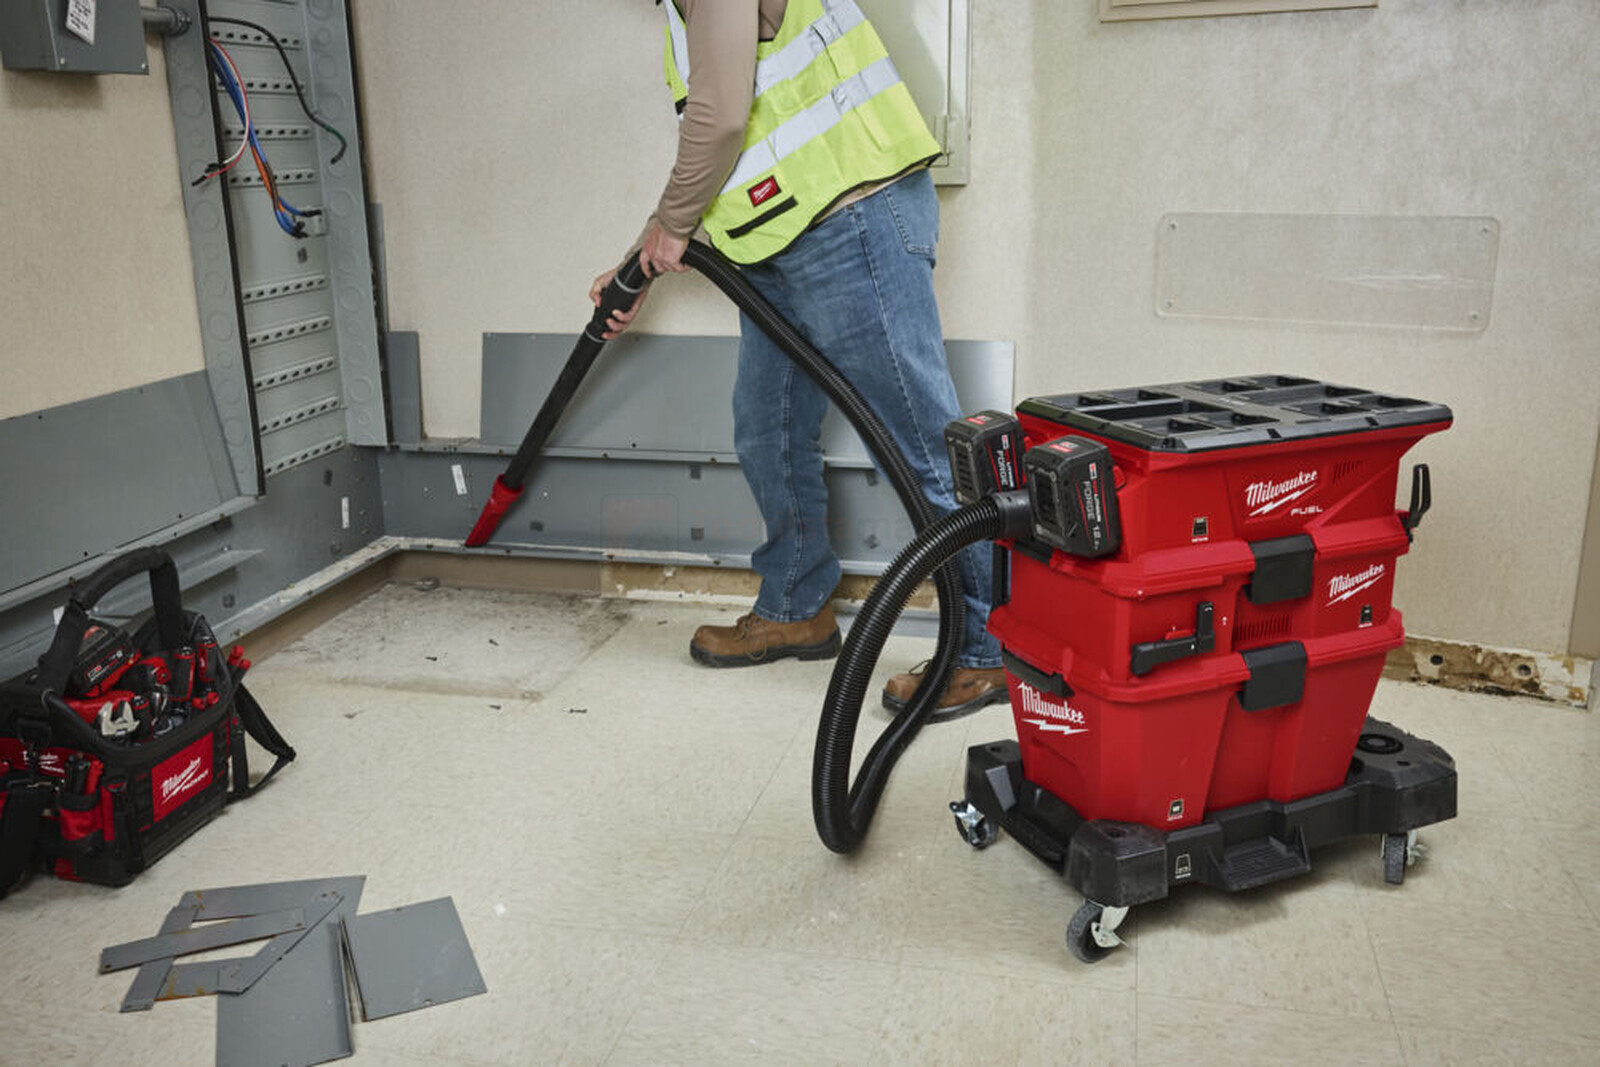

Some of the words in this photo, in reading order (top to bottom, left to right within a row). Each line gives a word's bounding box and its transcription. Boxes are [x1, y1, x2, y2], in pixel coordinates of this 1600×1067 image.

[1083, 481, 1095, 520] FORGE
[1244, 470, 1318, 506] Milwaukee
[1290, 505, 1323, 517] FUEL
[1328, 564, 1384, 598] Milwaukee
[1017, 681, 1085, 724] Milwaukee
